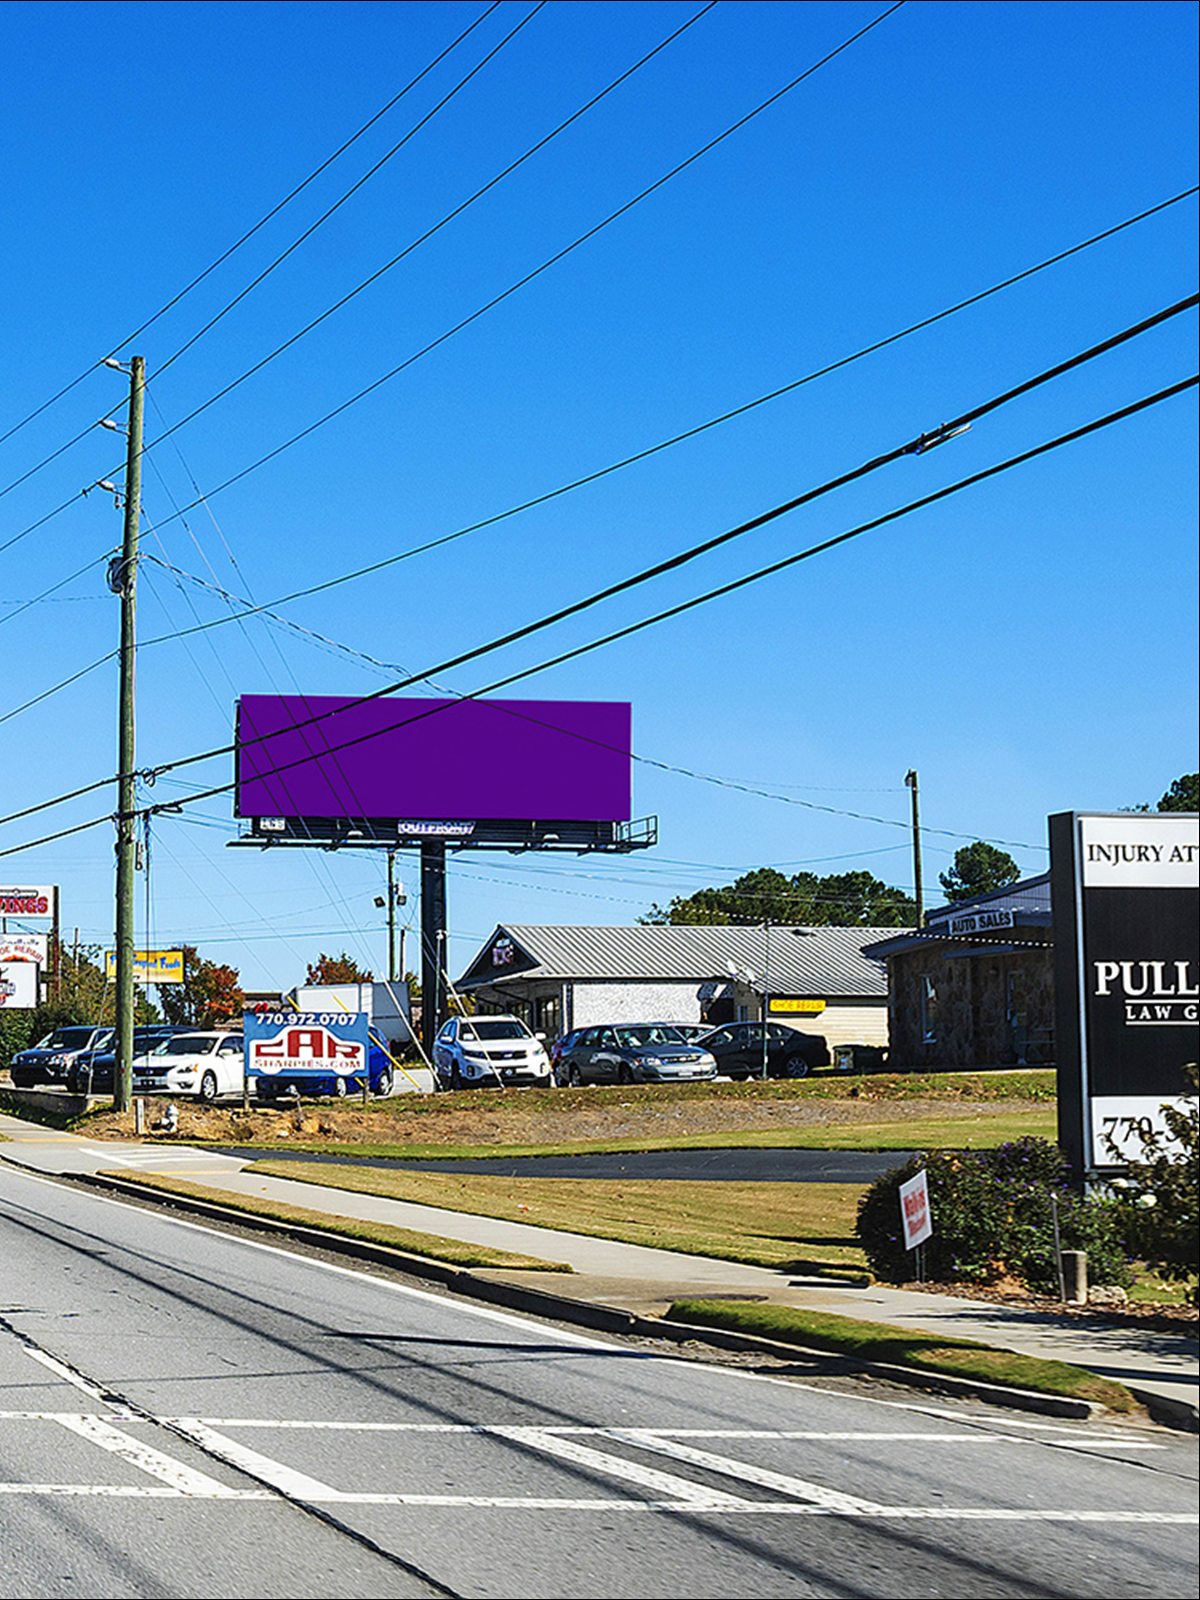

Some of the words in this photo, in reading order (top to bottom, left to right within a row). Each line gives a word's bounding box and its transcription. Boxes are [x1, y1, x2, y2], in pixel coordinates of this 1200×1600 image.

[1087, 844, 1164, 866] INJURY
[951, 917, 976, 933] AUTO
[979, 911, 1012, 929] SALES
[1093, 961, 1199, 996] PULL
[255, 1013, 358, 1026] 770.972.0707
[1125, 1005, 1172, 1020] LAW
[255, 1030, 361, 1058] CAR
